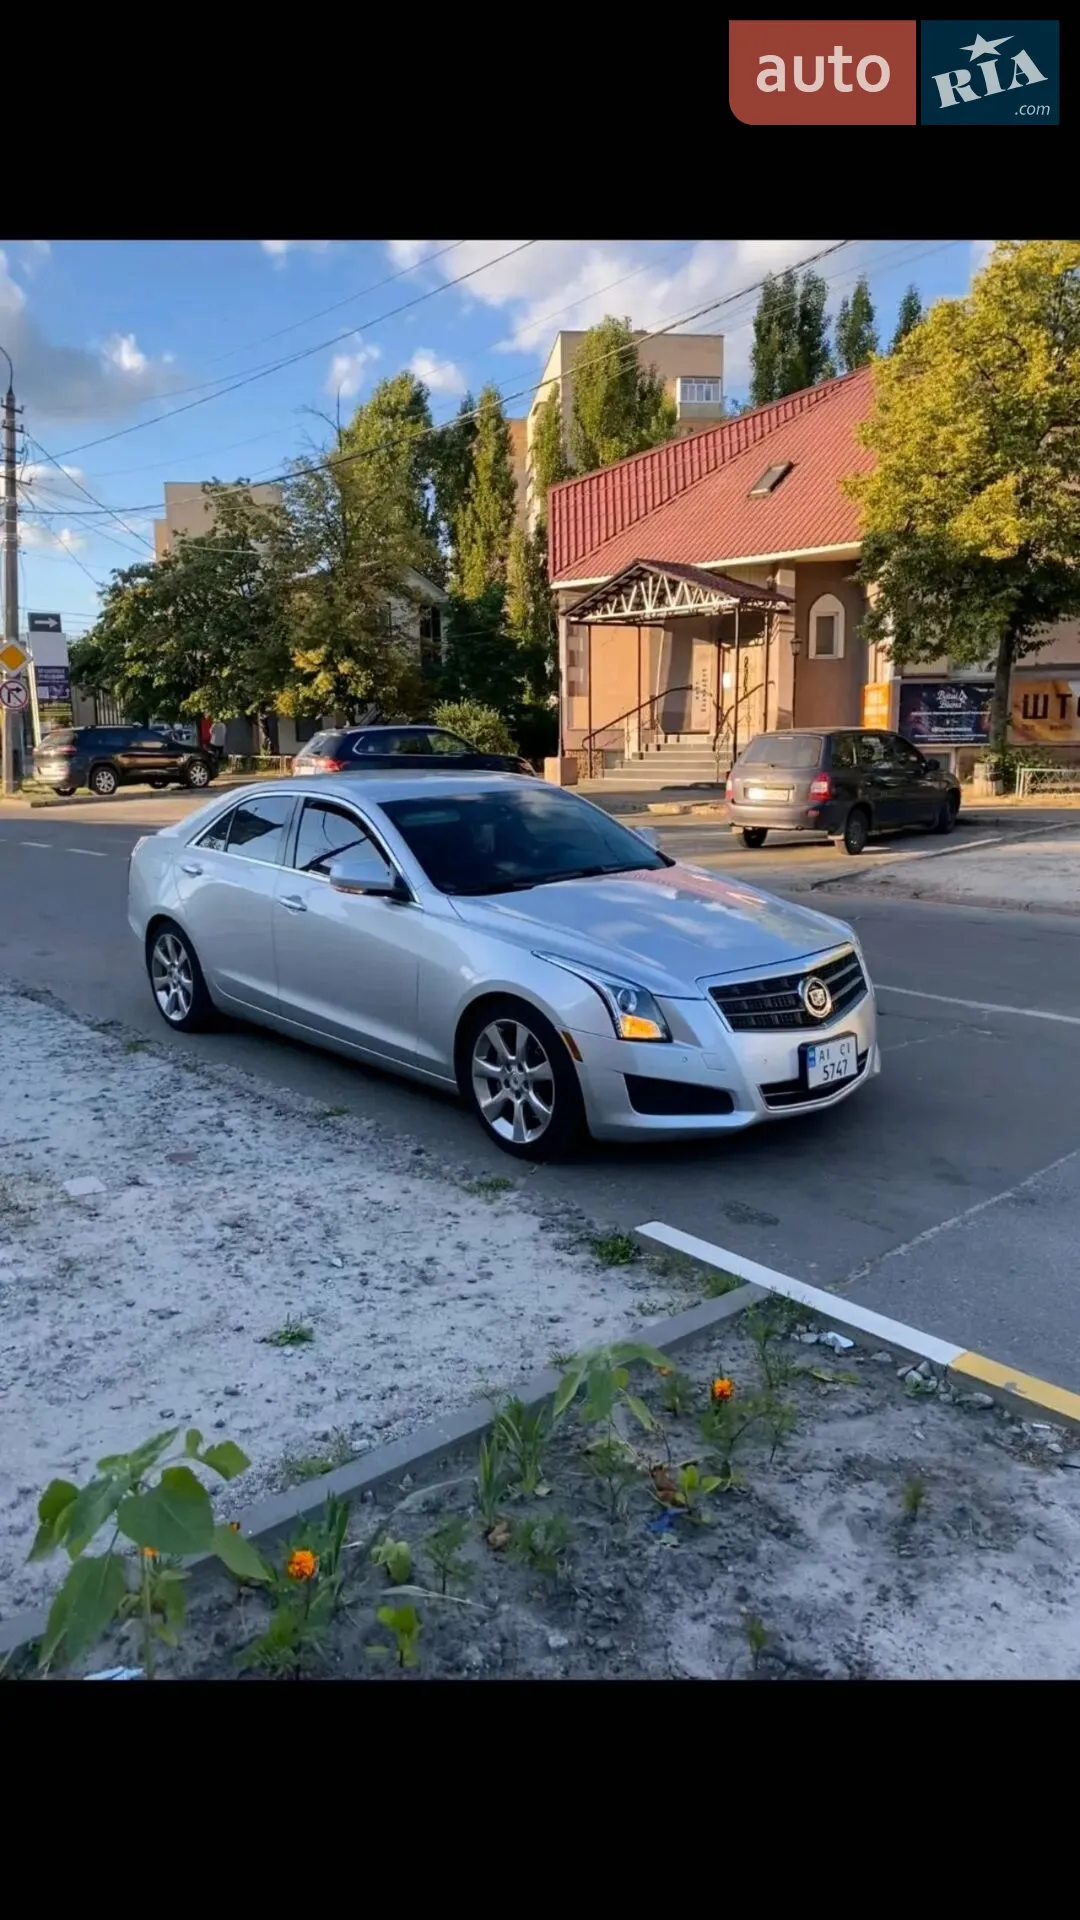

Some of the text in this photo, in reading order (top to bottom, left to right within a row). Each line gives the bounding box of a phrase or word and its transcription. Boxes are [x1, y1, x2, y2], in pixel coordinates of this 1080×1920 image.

[1022, 693, 1080, 720] ШТ
[819, 1048, 830, 1062] AI
[823, 1059, 848, 1081] 5747
